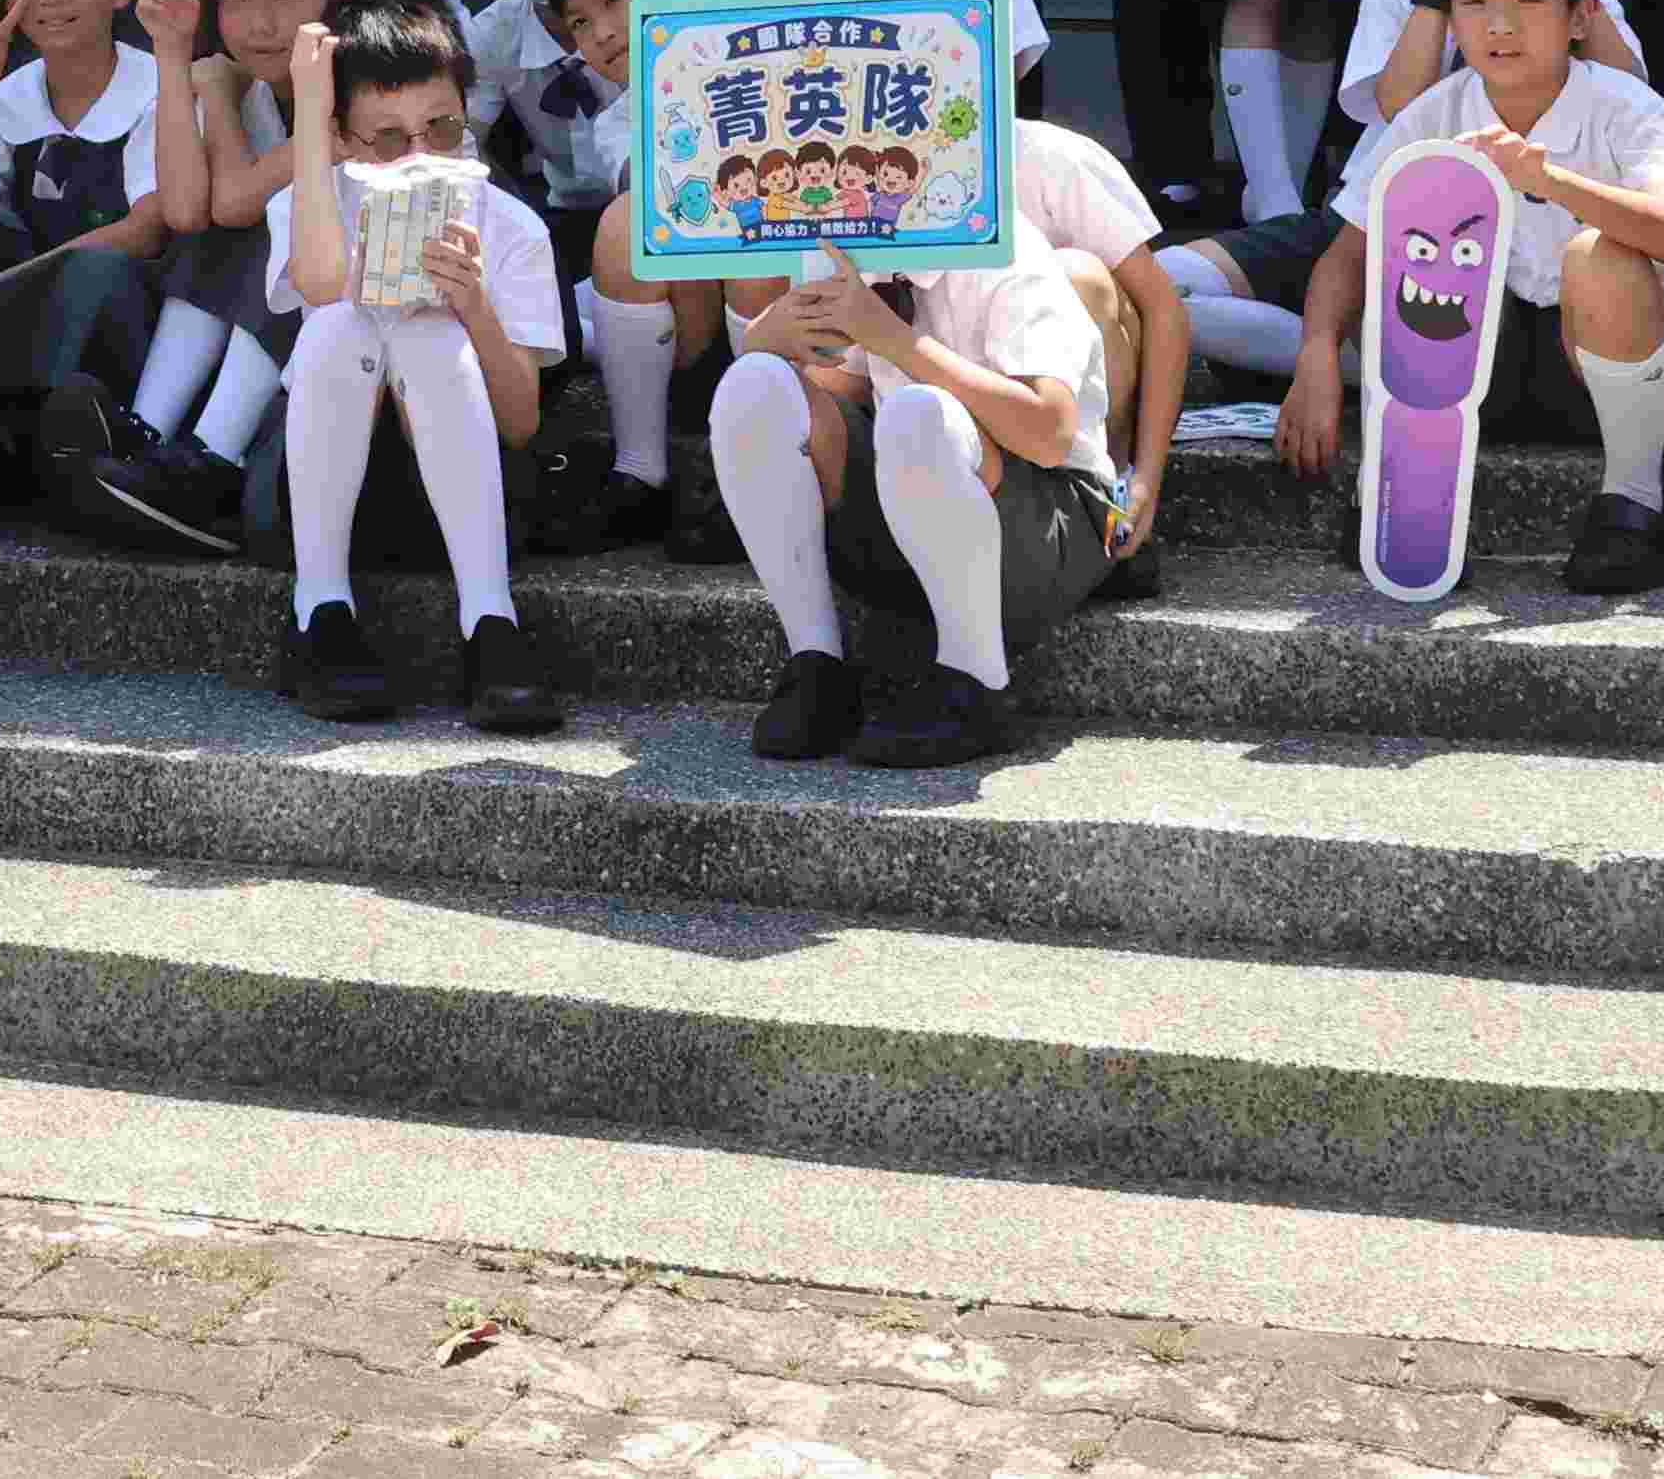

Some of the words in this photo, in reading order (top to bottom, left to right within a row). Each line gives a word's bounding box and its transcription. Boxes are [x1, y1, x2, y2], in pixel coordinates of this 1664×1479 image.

[756, 19, 863, 49] 團隊合作
[703, 62, 933, 148] 菁英隊
